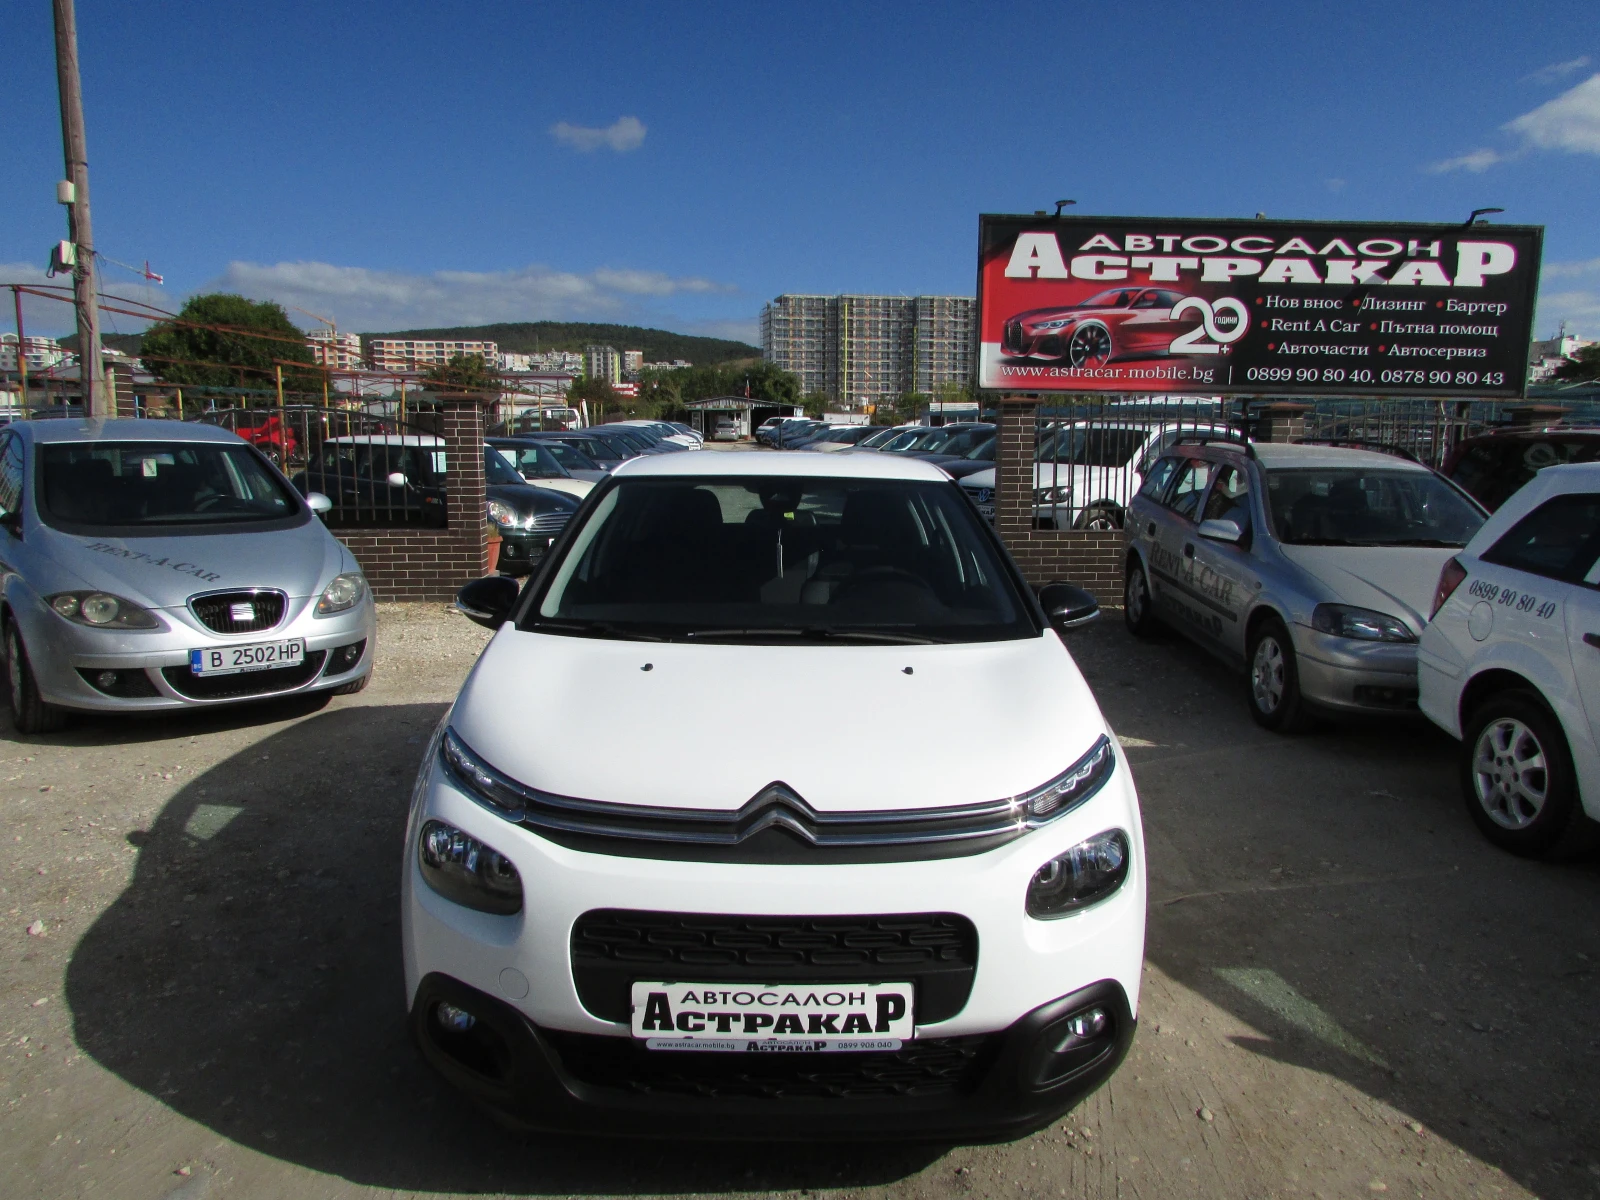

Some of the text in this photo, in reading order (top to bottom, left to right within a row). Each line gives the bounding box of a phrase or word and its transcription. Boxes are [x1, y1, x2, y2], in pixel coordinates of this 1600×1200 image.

[1078, 234, 1438, 257] АВТОСАЛОН
[1004, 232, 1515, 287] АСТРАКАР
[1266, 295, 1507, 316] Нов внос Лизинг Бартер
[1214, 316, 1238, 325] ГОДИНИ
[1271, 319, 1361, 333] Rent A Car
[1380, 320, 1499, 338] Пътна помощ
[1277, 341, 1486, 360] Авточасти Автосервиз
[1001, 366, 1214, 383] www.astracar.mobile.bg
[1247, 367, 1503, 385] 0899 90 80 40, 0878 90 80 43
[1469, 580, 1556, 619] 0899 90 80 40
[233, 646, 276, 666] 2502
[680, 990, 866, 1006] АВТОСАЛОН
[642, 992, 906, 1034] АСТРАКАР
[656, 1042, 735, 1050] www.astracar.mobile.bg
[746, 1040, 827, 1051] АСТРАКАР
